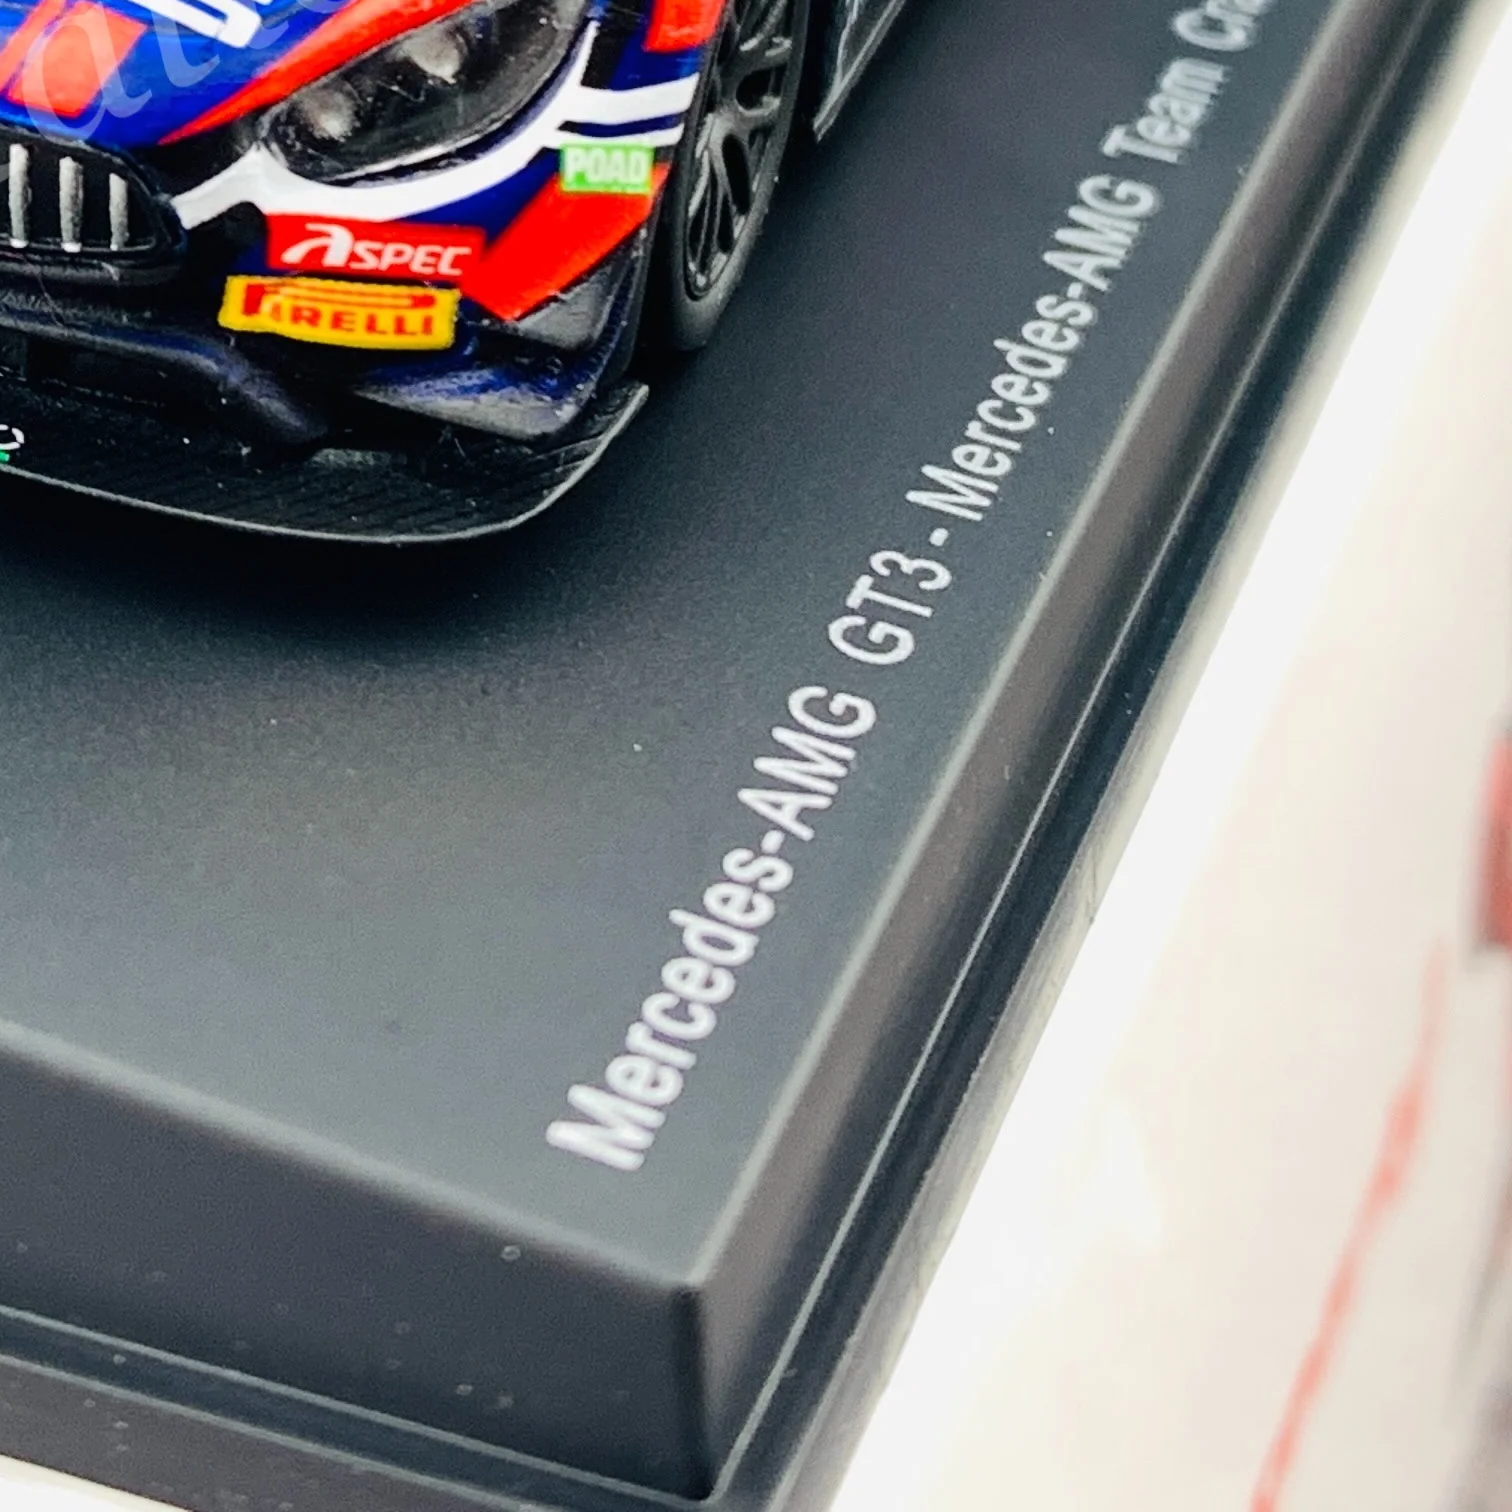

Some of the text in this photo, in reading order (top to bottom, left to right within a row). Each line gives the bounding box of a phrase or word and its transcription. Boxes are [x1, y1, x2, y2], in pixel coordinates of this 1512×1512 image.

[565, 146, 649, 185] POAD
[241, 281, 438, 338] PIRELLI
[545, 684, 878, 1172] Mercedes-AMG
[828, 549, 953, 665] GT3
[905, 174, 1158, 522] Mercedes-AMG
[1101, 56, 1230, 164] Team
